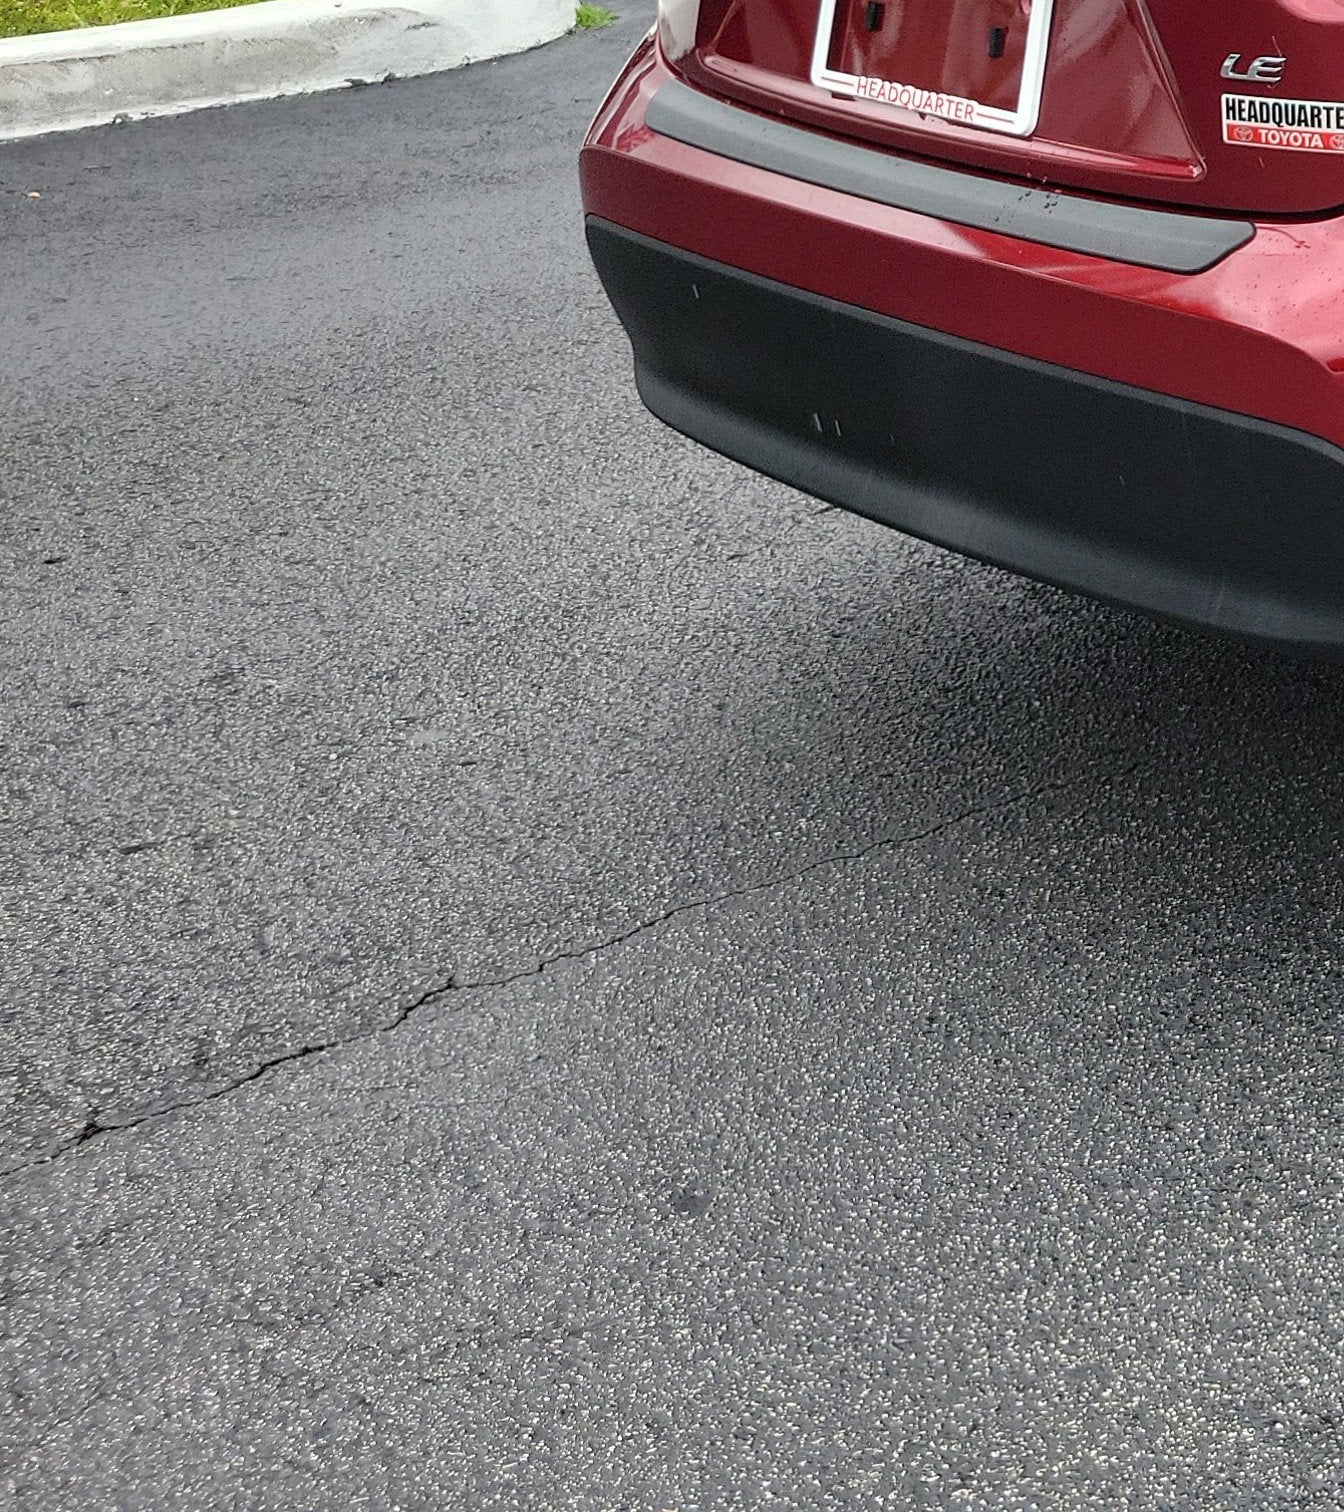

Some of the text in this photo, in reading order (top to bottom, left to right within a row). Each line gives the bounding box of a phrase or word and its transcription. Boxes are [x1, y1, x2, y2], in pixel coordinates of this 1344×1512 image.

[1221, 54, 1287, 83] LE
[856, 76, 975, 122] HEADQUARTER
[1257, 128, 1325, 149] TOYOTA
